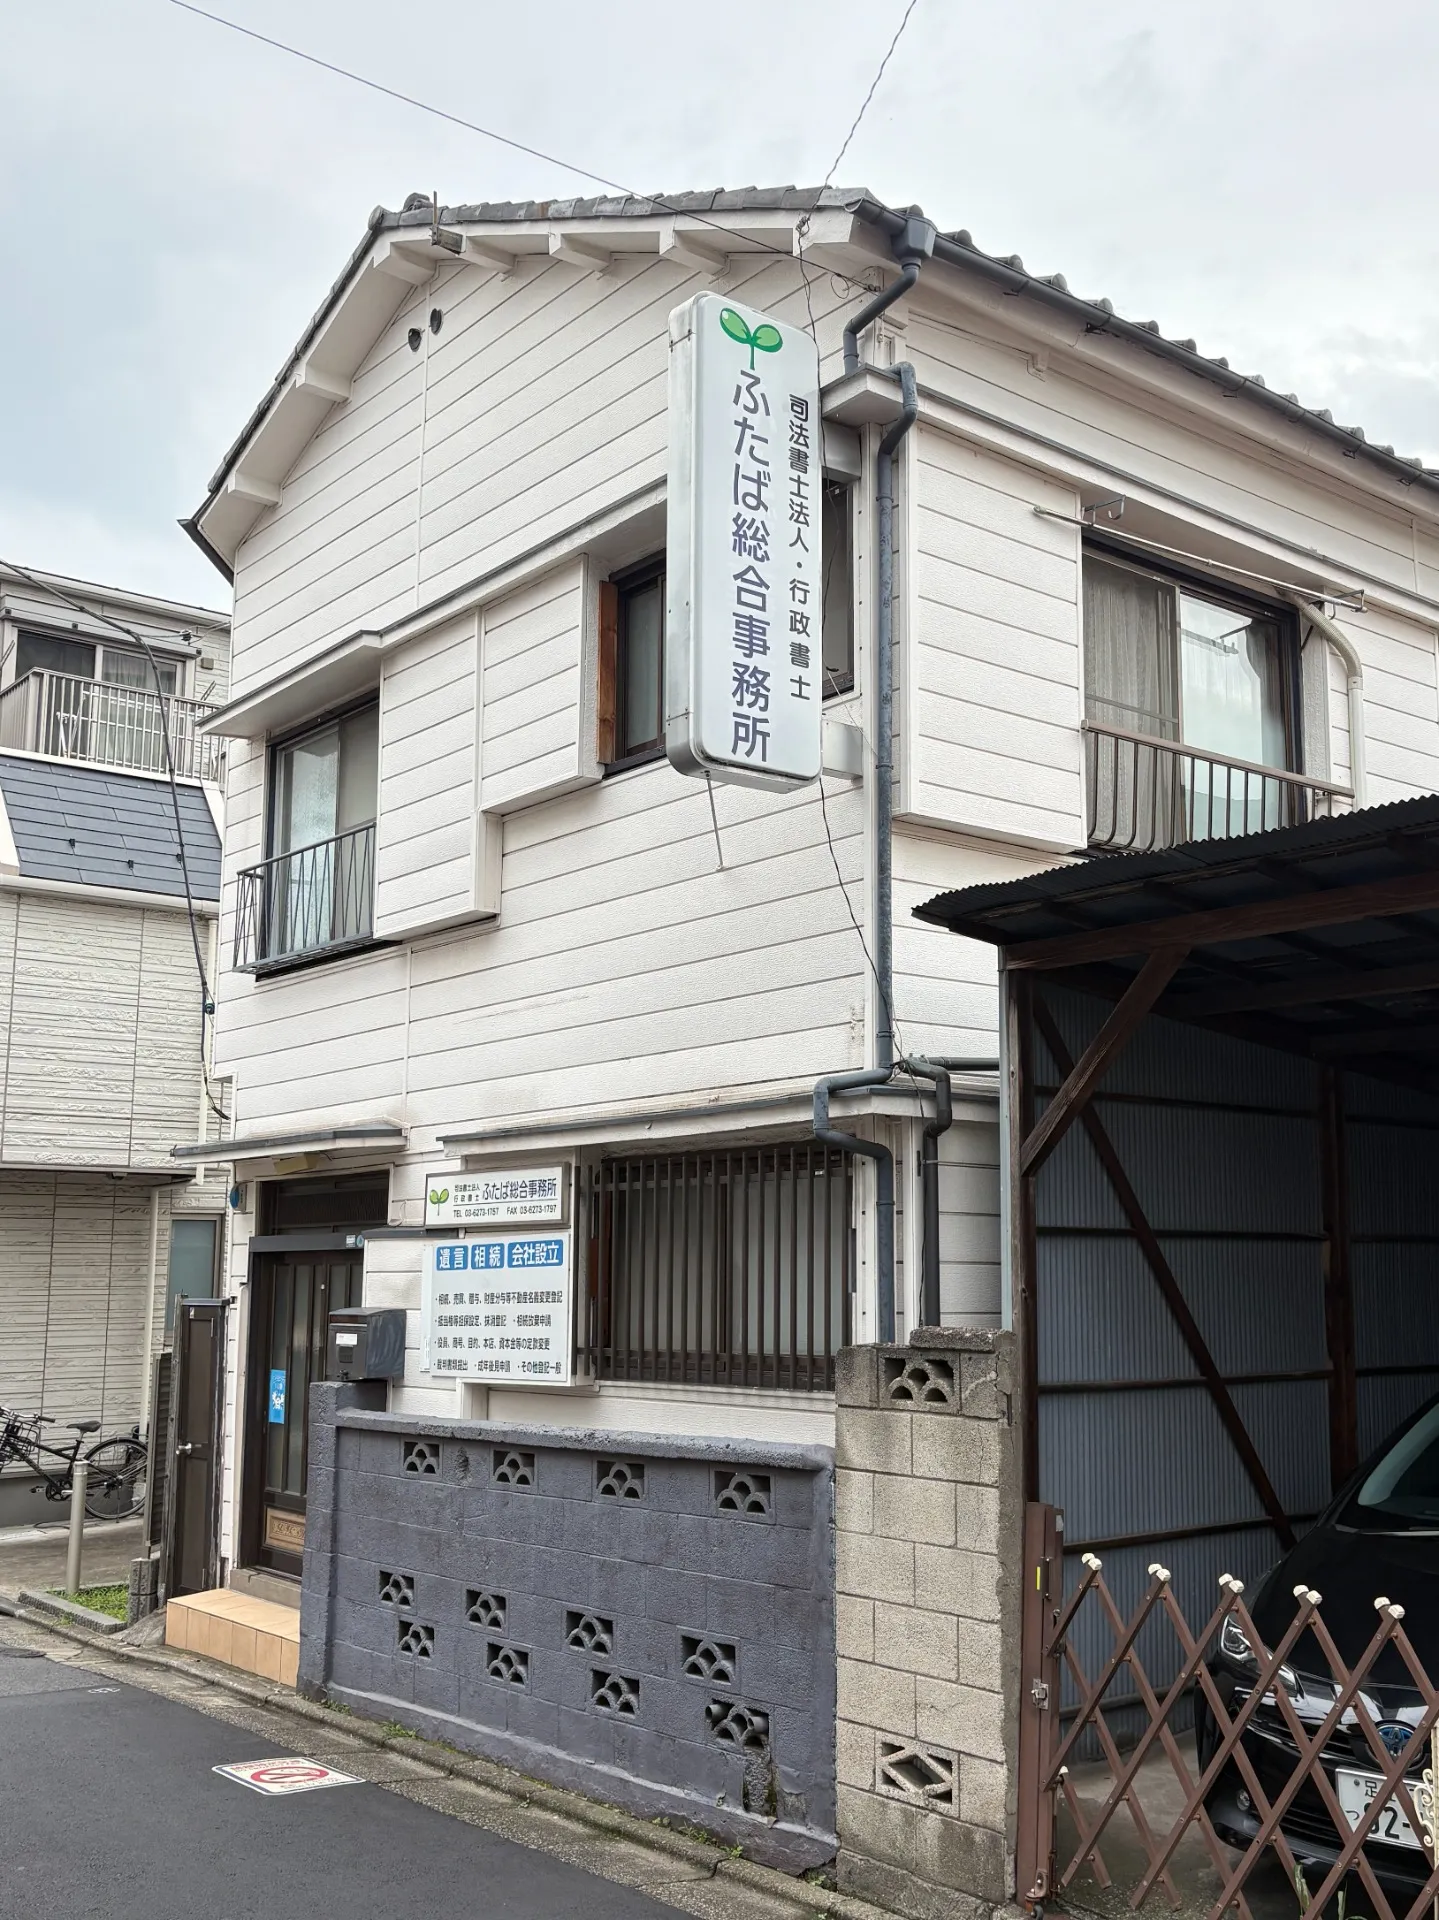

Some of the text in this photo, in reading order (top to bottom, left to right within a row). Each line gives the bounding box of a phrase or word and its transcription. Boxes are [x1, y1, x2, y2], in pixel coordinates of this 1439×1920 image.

[788, 392, 811, 701] 司法書士法人・行政書士
[731, 368, 771, 763] ふたば総合事務所
[453, 1194, 480, 1203] 行政書士
[482, 1177, 557, 1201] ふたば総合事務所
[453, 1209, 462, 1218] TEL
[506, 1206, 518, 1216] FAX
[439, 1242, 560, 1269] 遺言 相続 会社設立
